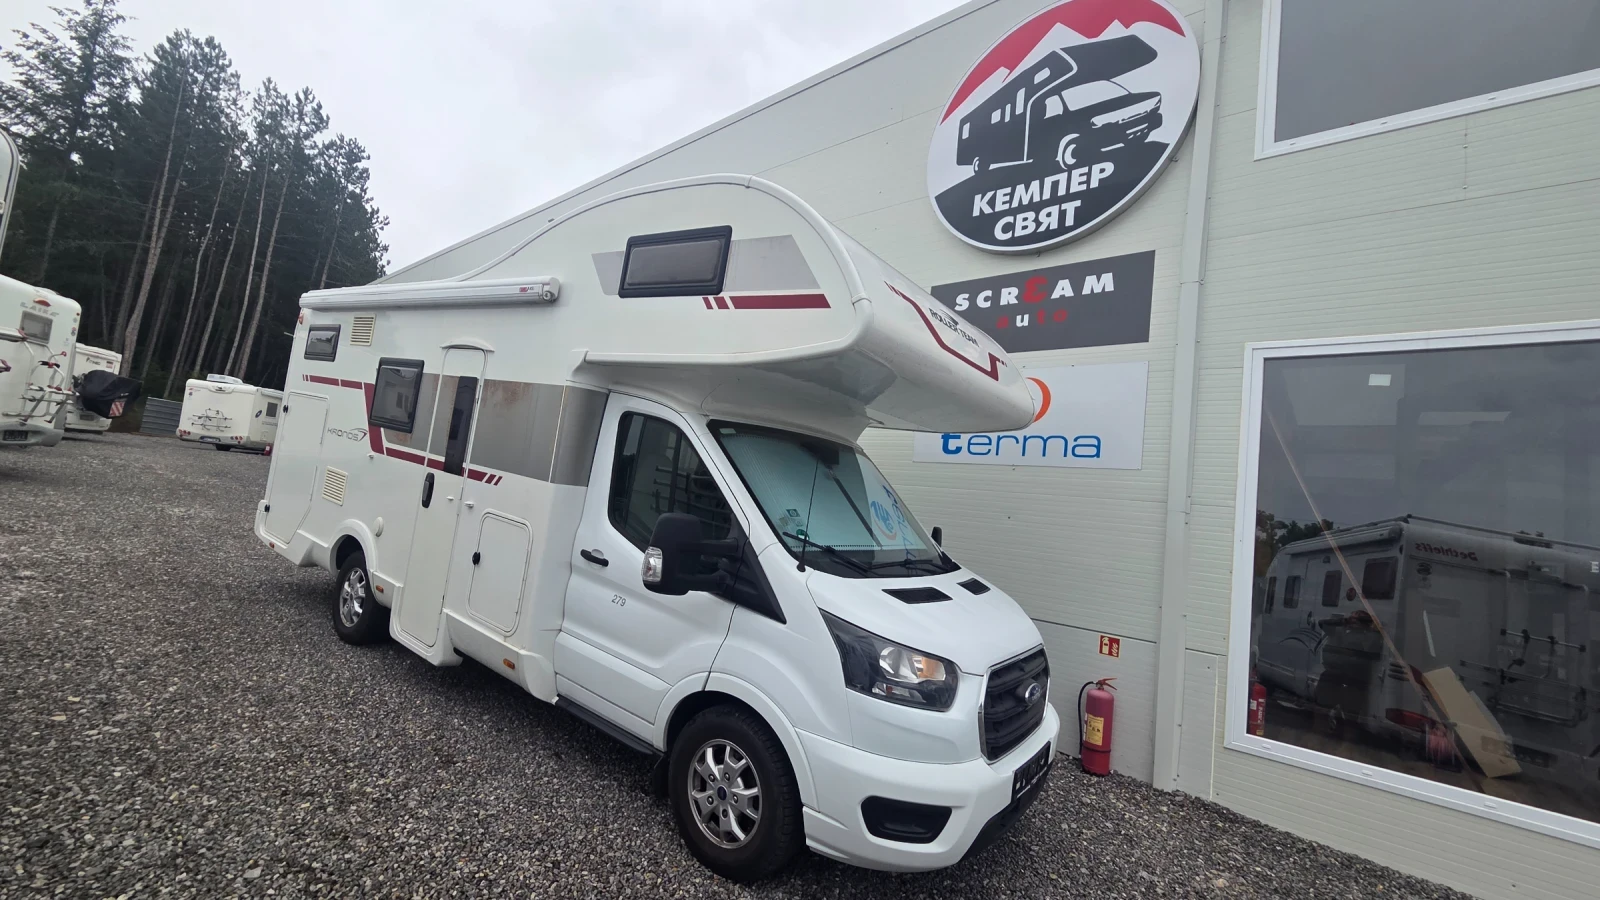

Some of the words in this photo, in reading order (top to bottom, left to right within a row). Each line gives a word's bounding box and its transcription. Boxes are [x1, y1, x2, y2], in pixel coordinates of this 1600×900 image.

[972, 161, 1115, 217] КЕМПЕР
[993, 199, 1082, 241] СВЯТ
[996, 308, 1069, 330] auto
[940, 432, 1102, 459] terma
[611, 594, 627, 607] 279
